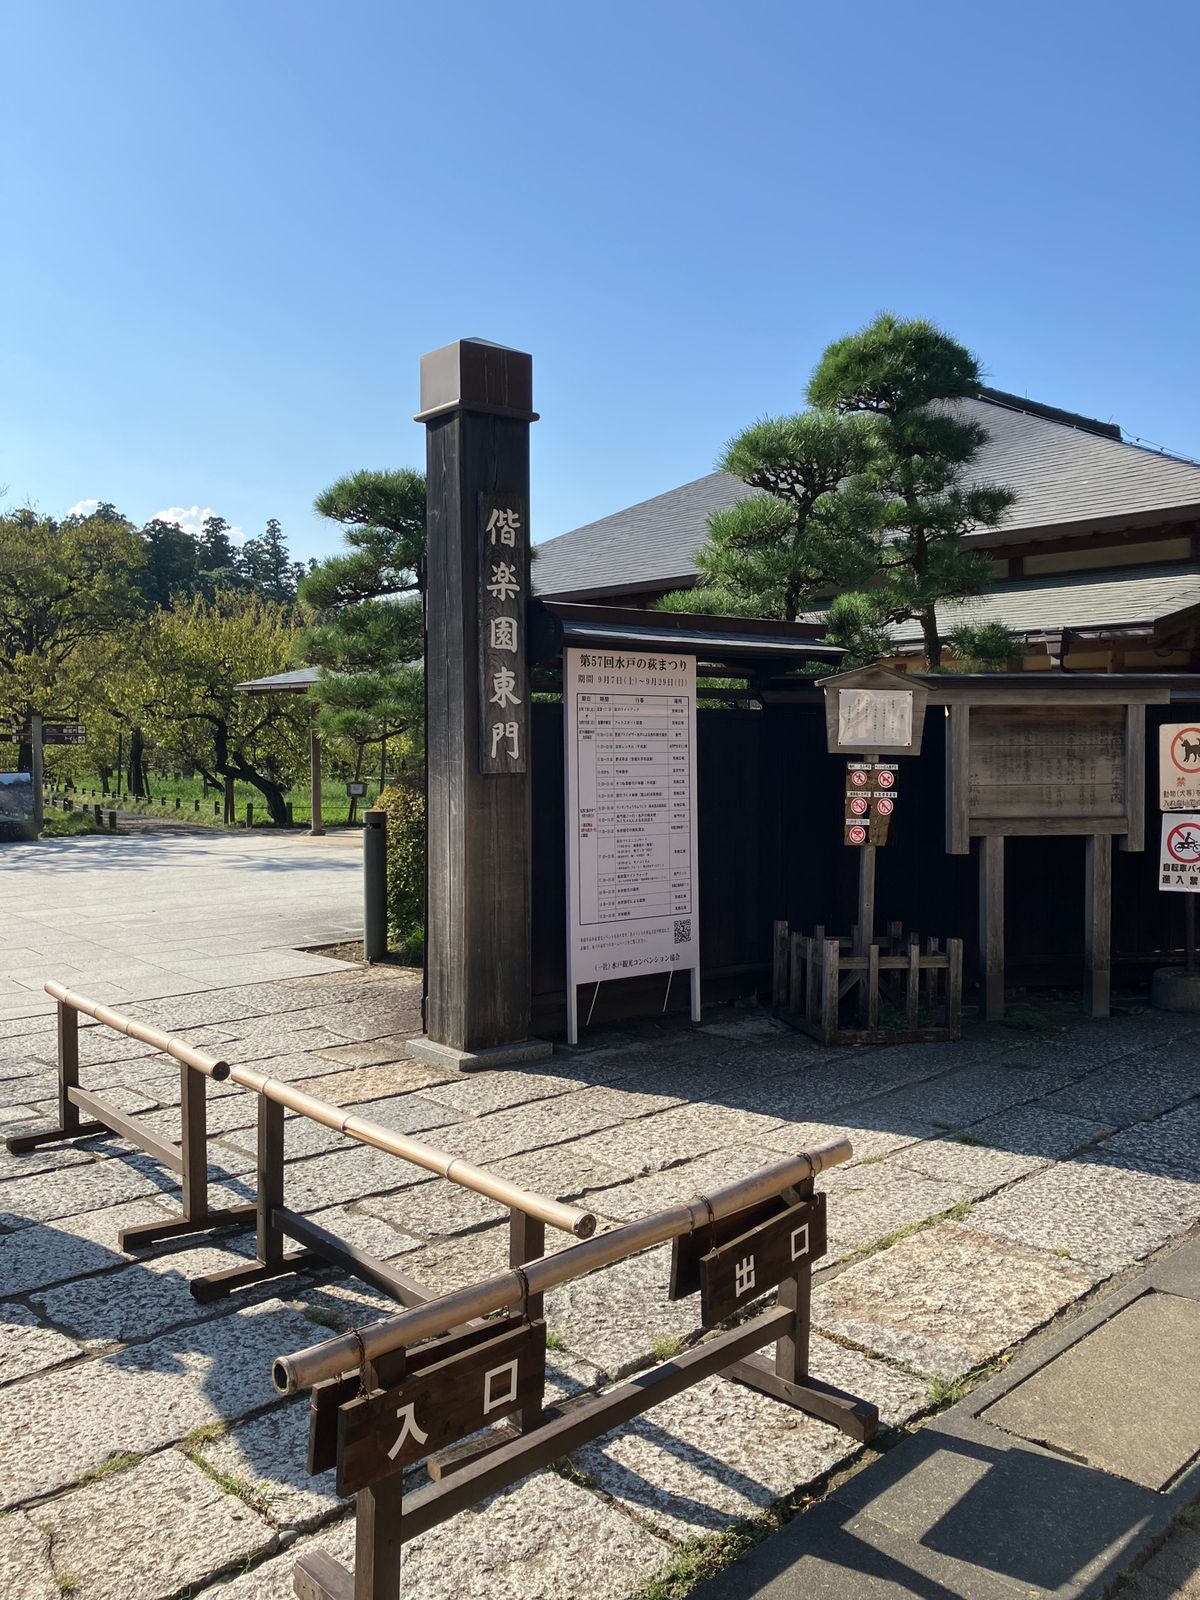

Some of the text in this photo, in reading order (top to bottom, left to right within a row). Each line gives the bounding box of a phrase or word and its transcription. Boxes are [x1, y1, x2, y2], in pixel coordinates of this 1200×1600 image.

[486, 508, 521, 760] 偕楽園東門
[580, 654, 687, 671] 第57回水戸の萩まつり
[735, 1223, 809, 1297] 出口
[387, 1359, 519, 1461] 入口
